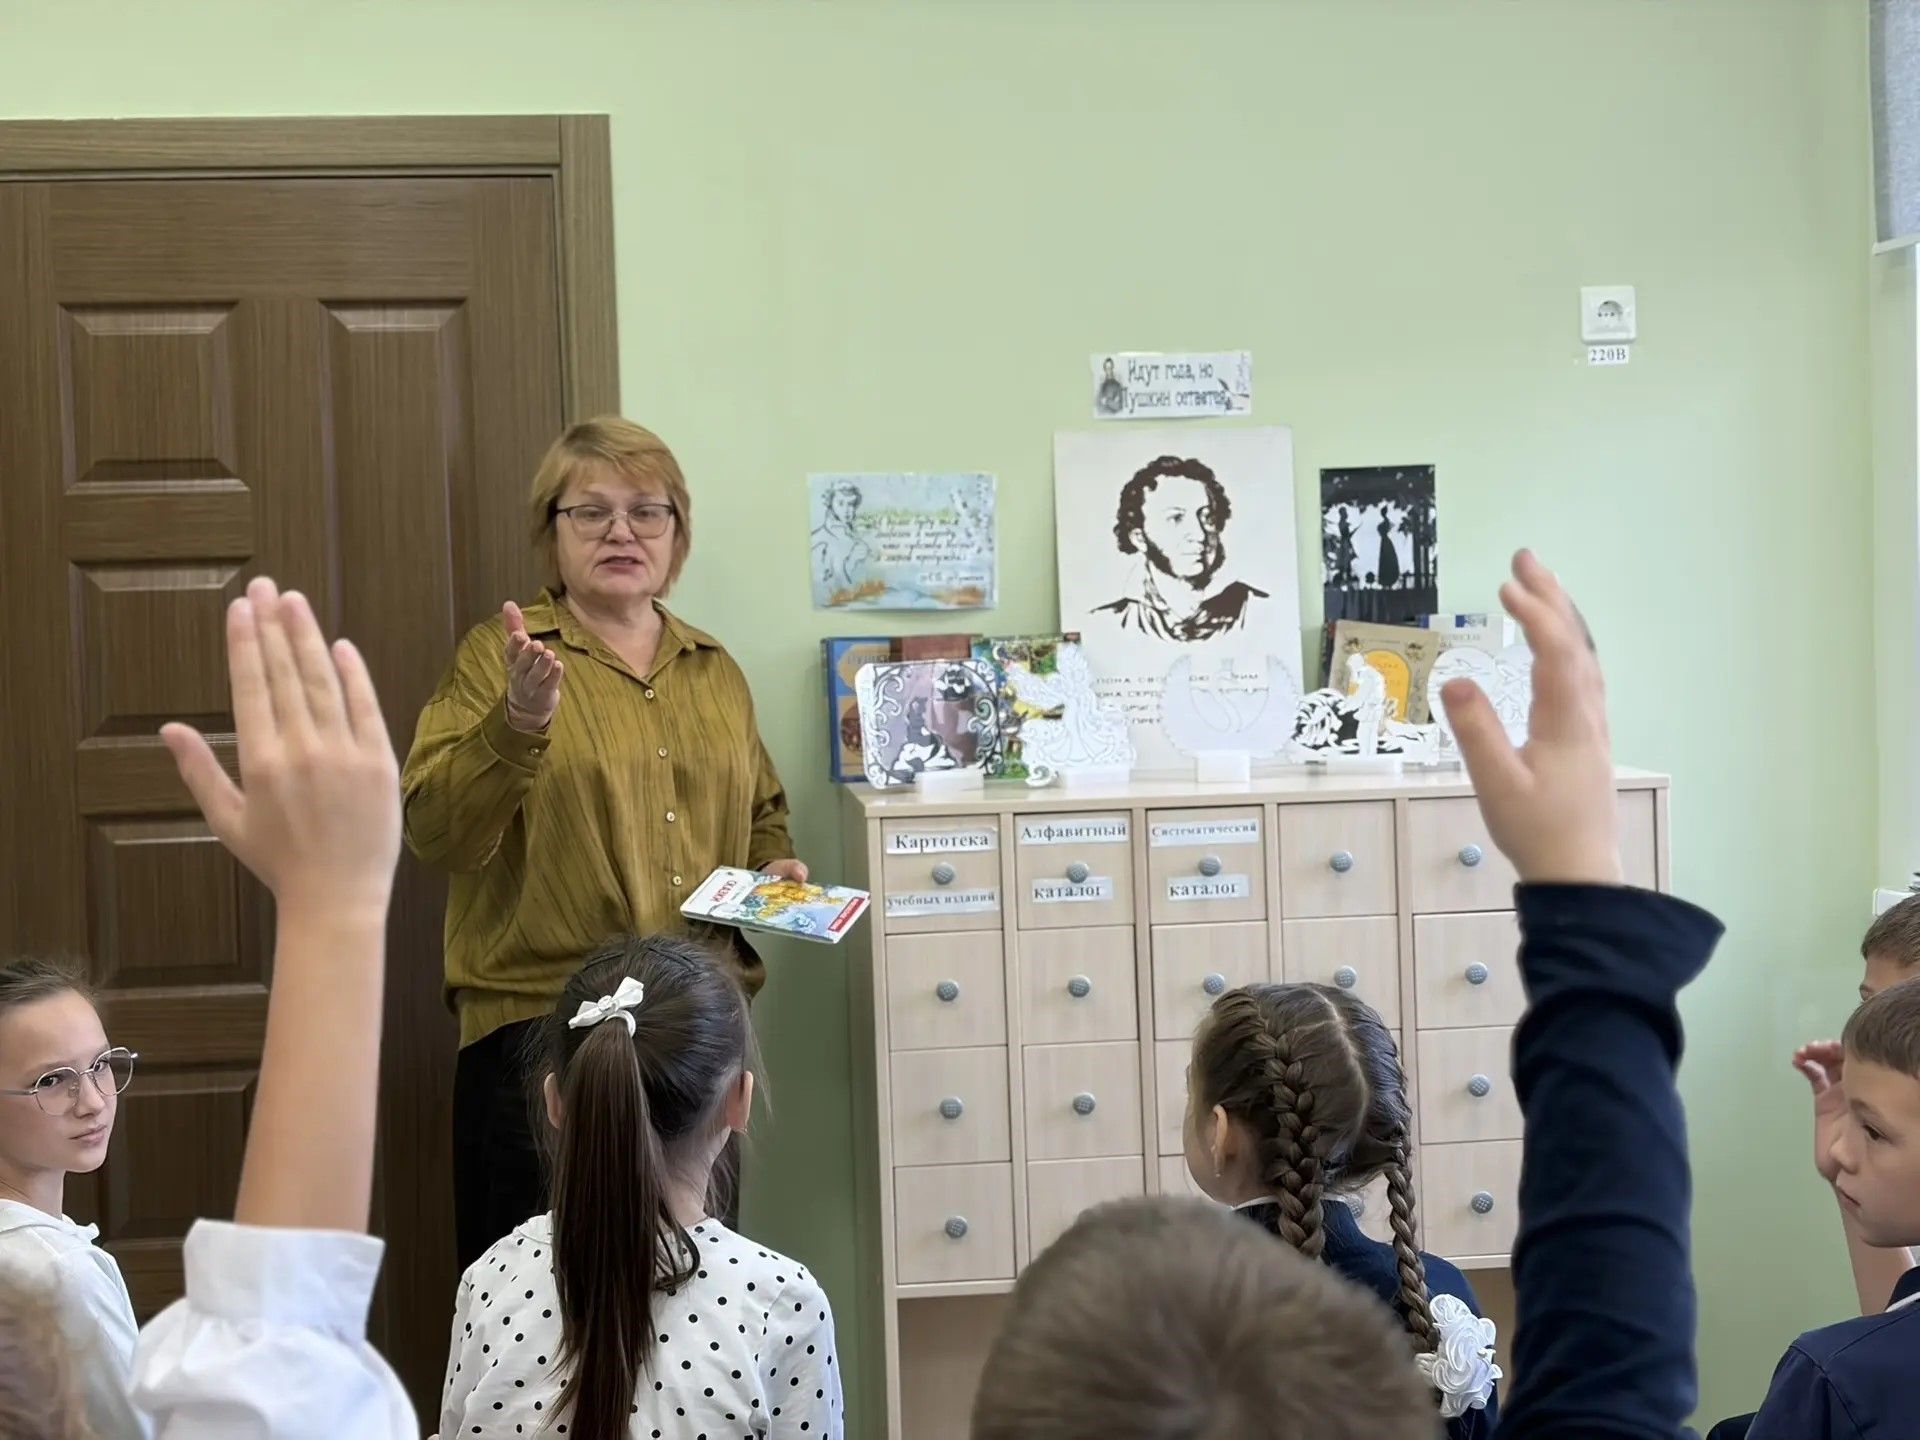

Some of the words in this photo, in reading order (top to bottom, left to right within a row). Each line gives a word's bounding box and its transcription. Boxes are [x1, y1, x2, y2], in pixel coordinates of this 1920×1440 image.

[1591, 348, 1626, 362] 220В
[1127, 359, 1160, 387] Идут
[1199, 362, 1214, 379] но
[1021, 823, 1127, 841] Алфавитный
[1152, 822, 1257, 837] Систематический
[896, 834, 989, 853] Картотека
[1034, 884, 1103, 899] каталог
[1170, 881, 1238, 897] каталог
[887, 893, 940, 909] учебных
[944, 891, 995, 904] изданий
